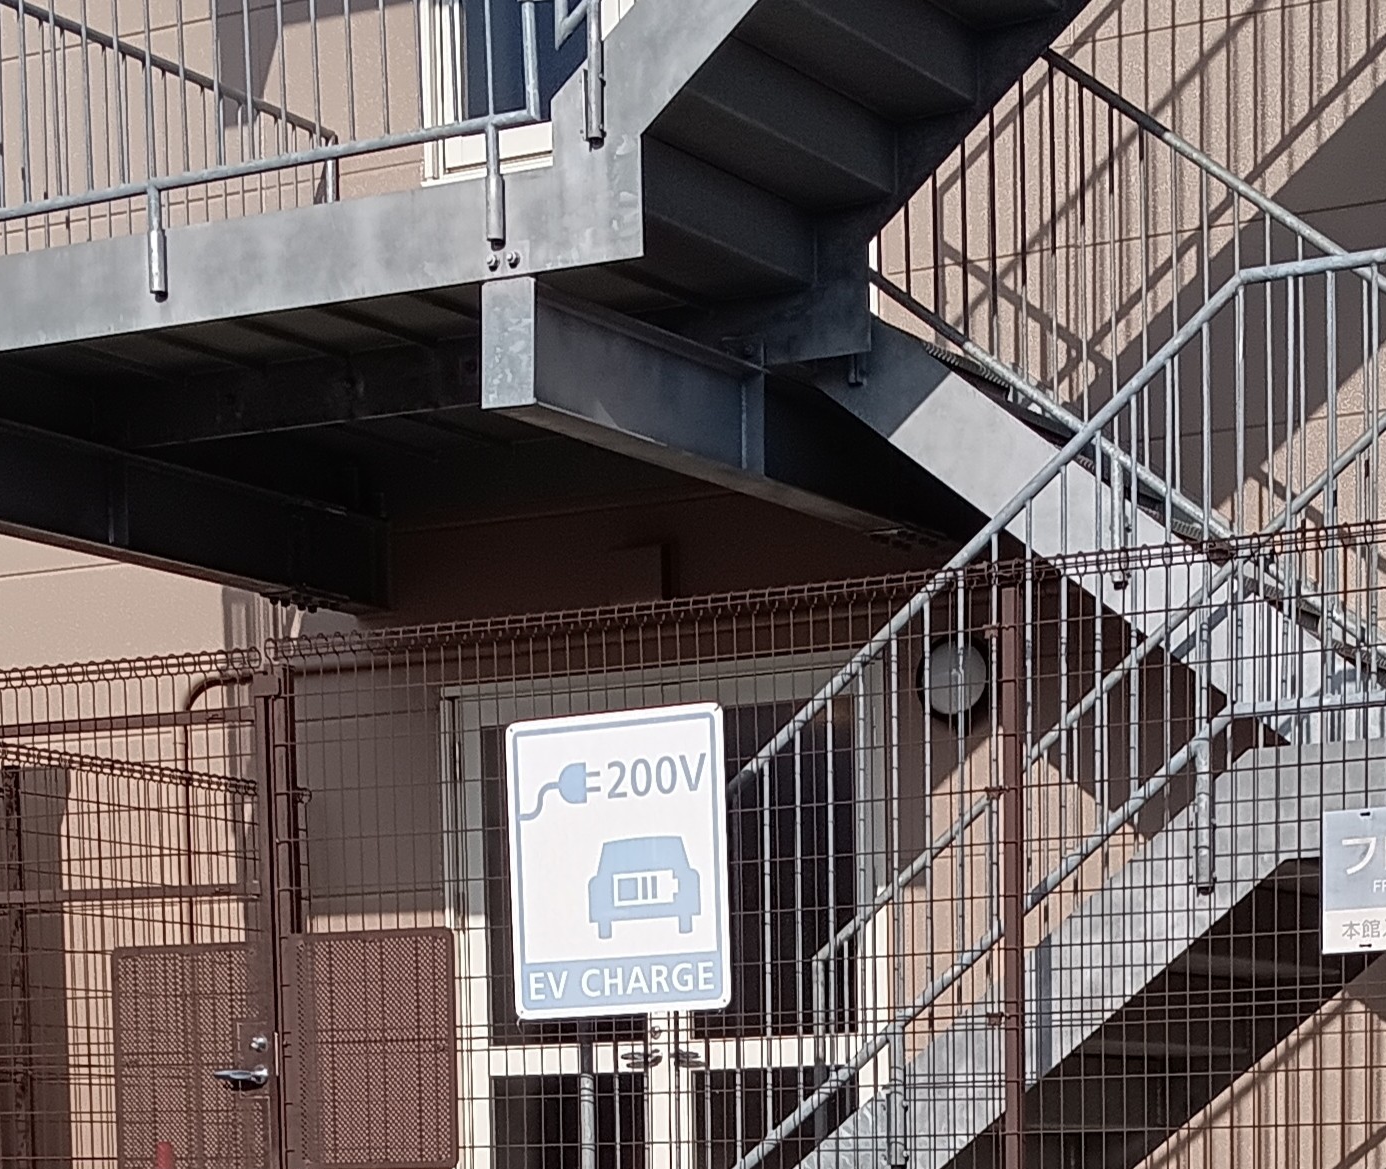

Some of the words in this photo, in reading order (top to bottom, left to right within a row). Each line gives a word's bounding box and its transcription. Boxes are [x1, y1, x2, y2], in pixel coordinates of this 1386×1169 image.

[607, 752, 707, 799] 200V
[529, 970, 568, 1001] EV
[581, 961, 714, 998] CHARGE
